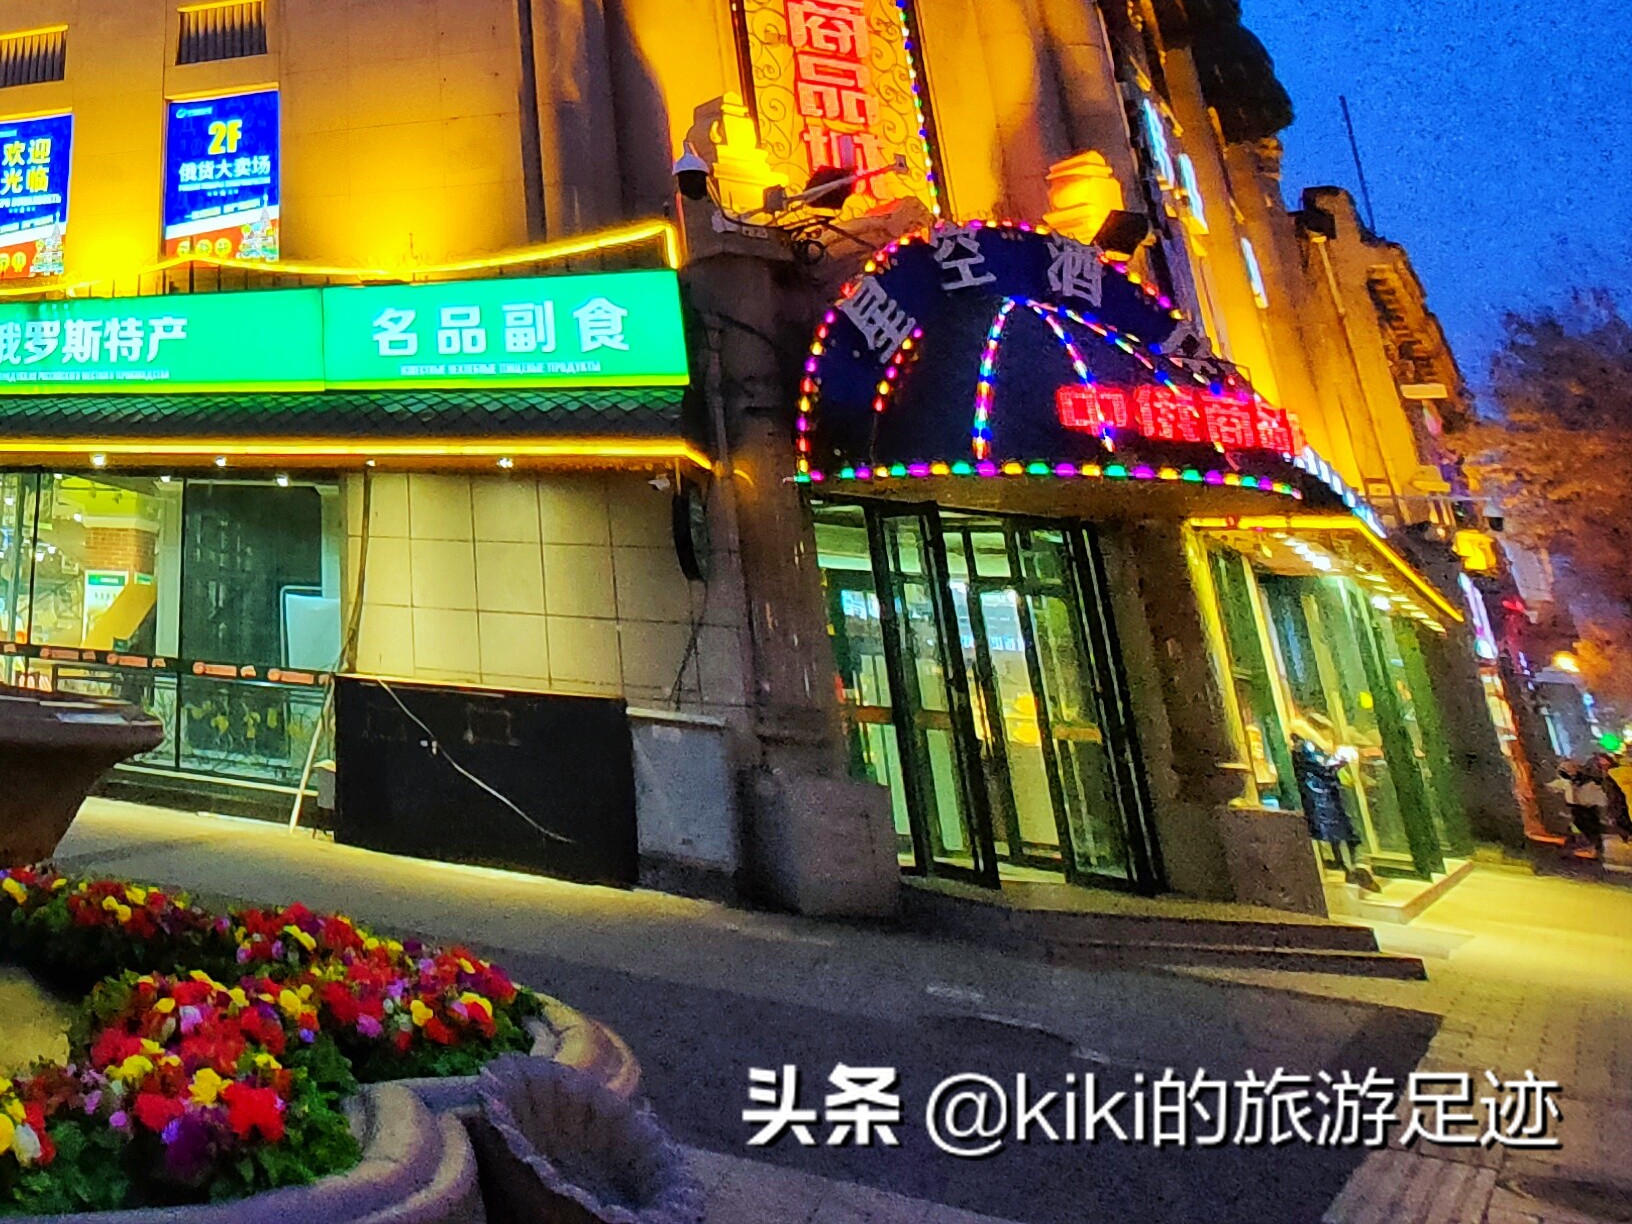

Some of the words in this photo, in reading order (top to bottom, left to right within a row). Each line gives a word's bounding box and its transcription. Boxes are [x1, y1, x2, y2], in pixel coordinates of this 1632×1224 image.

[1, 138, 52, 167] 欢迎
[207, 119, 243, 155] 2F
[0, 166, 50, 196] 光临
[178, 155, 271, 183] 俄货大卖场
[372, 297, 630, 357] 名品副食
[1056, 384, 1304, 458] 中俄商品
